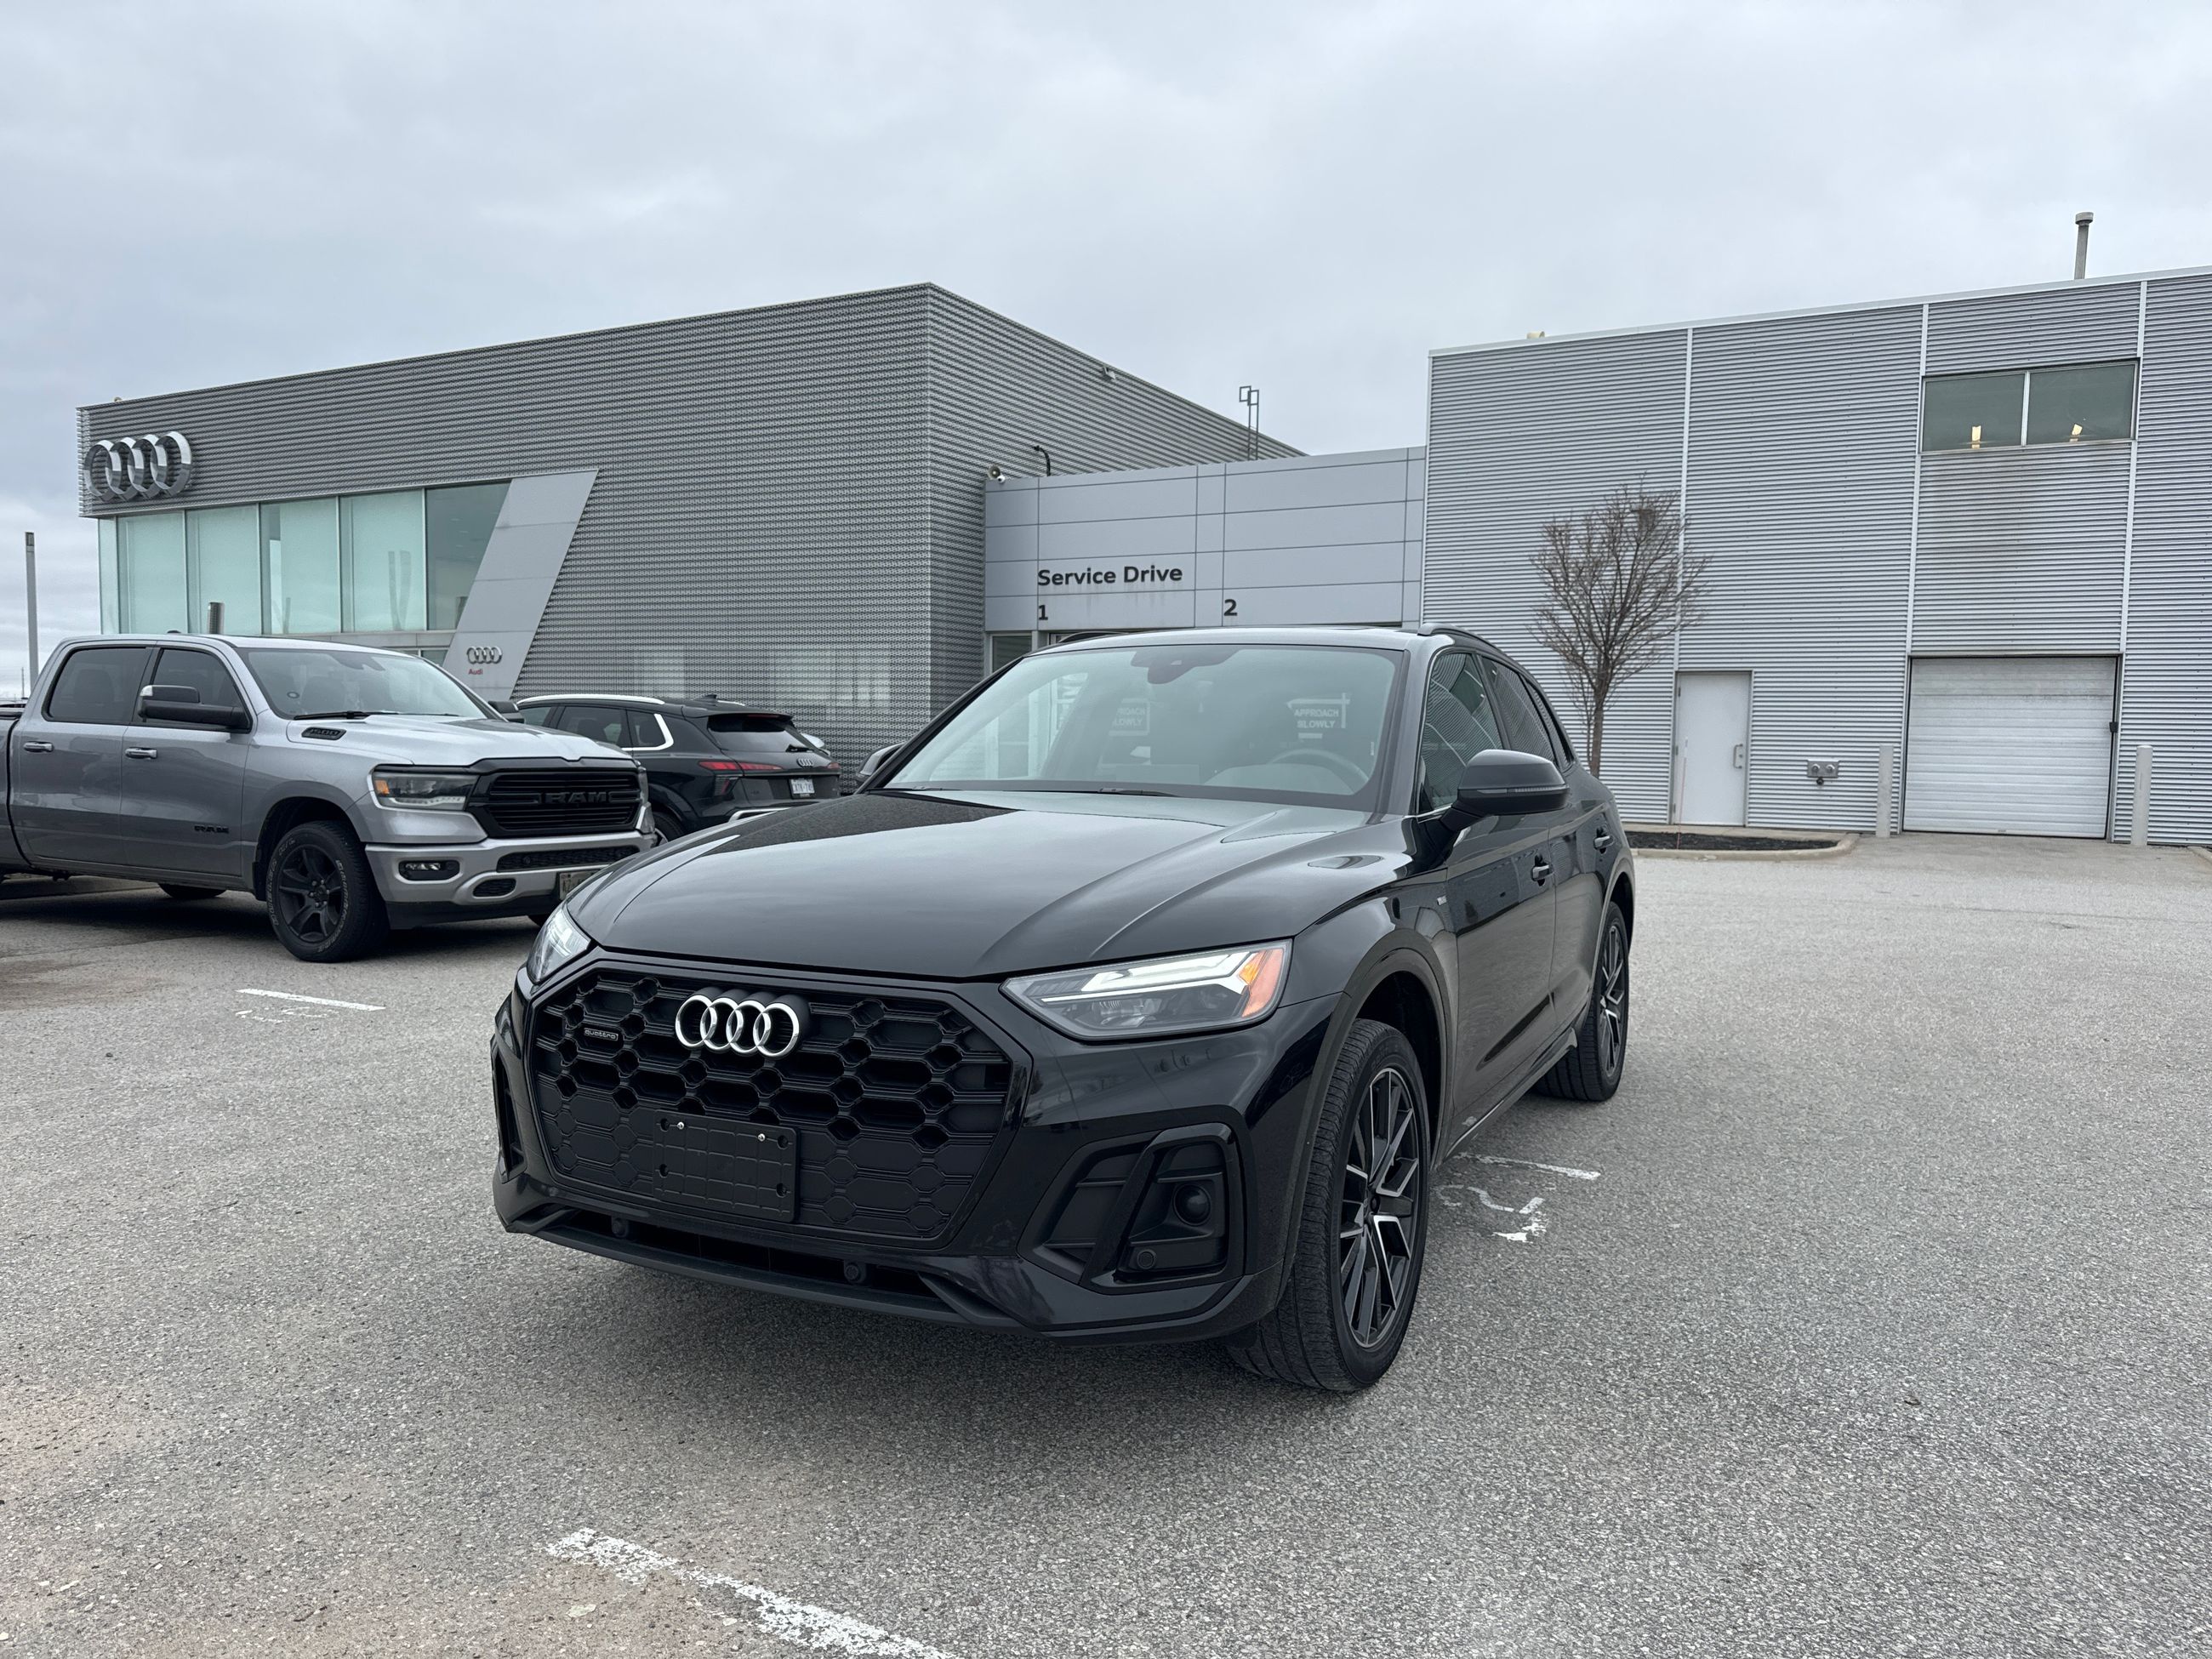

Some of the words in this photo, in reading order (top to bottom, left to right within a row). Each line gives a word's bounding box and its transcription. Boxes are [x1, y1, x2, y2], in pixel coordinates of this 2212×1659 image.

[1037, 567, 1116, 586] Service
[1123, 565, 1183, 584] Drive
[1038, 604, 1048, 621] 1
[1223, 598, 1238, 617] 2
[1294, 709, 1339, 717] APPROACH
[1297, 720, 1335, 728] SLOWLY
[544, 790, 607, 804] RAM
[584, 1029, 618, 1040] quattro
